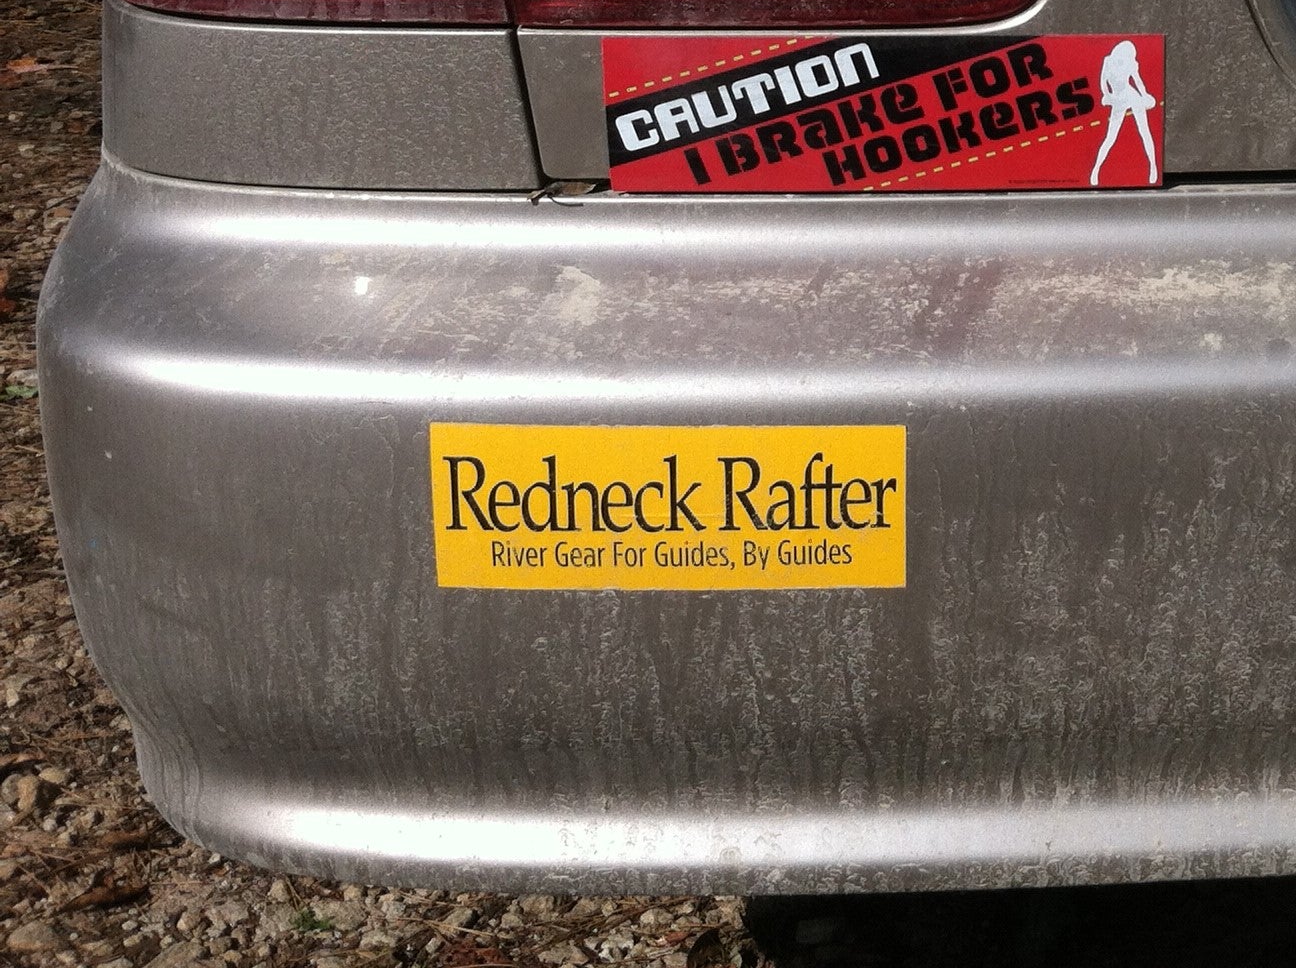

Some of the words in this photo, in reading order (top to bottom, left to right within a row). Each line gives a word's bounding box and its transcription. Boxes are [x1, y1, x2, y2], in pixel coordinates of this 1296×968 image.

[615, 42, 880, 152] CAUTION
[684, 147, 711, 185] I
[933, 43, 1054, 112] FOR
[443, 455, 706, 533] Redneck
[717, 453, 897, 530] Rafter
[491, 540, 547, 567] River
[555, 540, 605, 567] Gear
[612, 540, 647, 567] For
[654, 540, 736, 570] Guides,
[743, 539, 771, 570] By
[778, 539, 852, 566] Guides
